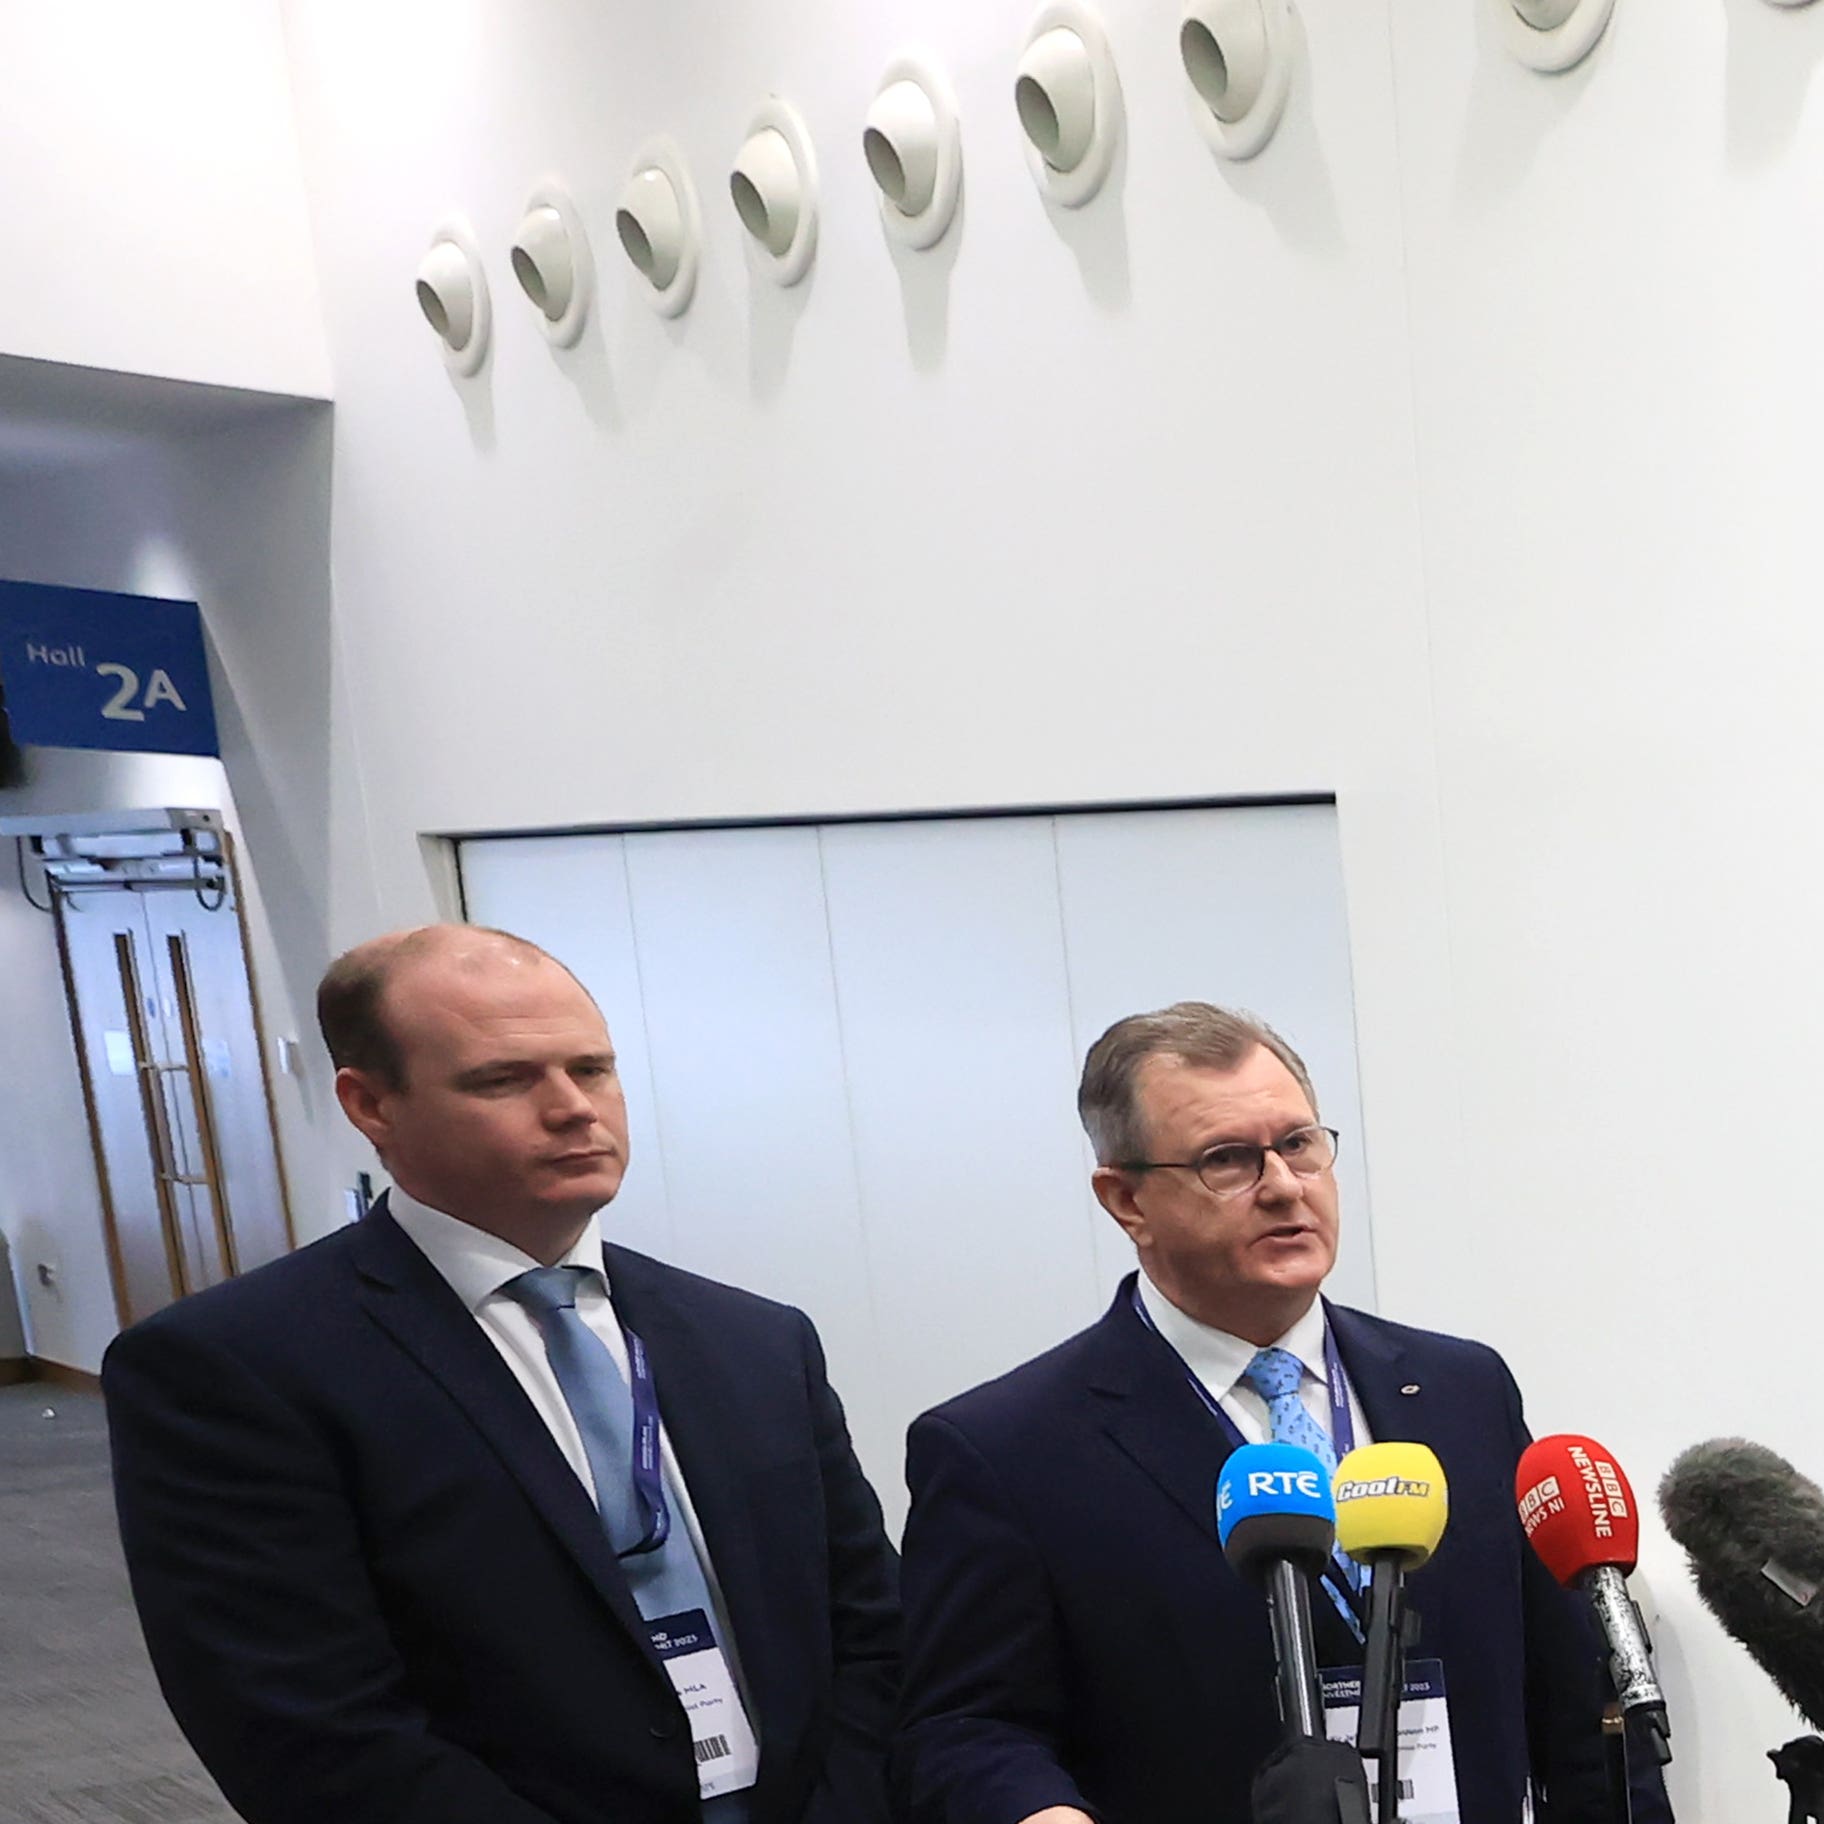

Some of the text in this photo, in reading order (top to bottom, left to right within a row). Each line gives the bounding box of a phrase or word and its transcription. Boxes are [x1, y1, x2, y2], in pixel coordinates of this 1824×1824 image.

[26, 643, 86, 667] Hall
[96, 662, 187, 721] 2A
[1568, 1446, 1613, 1538] NEWSLINE
[1594, 1461, 1628, 1518] BBC
